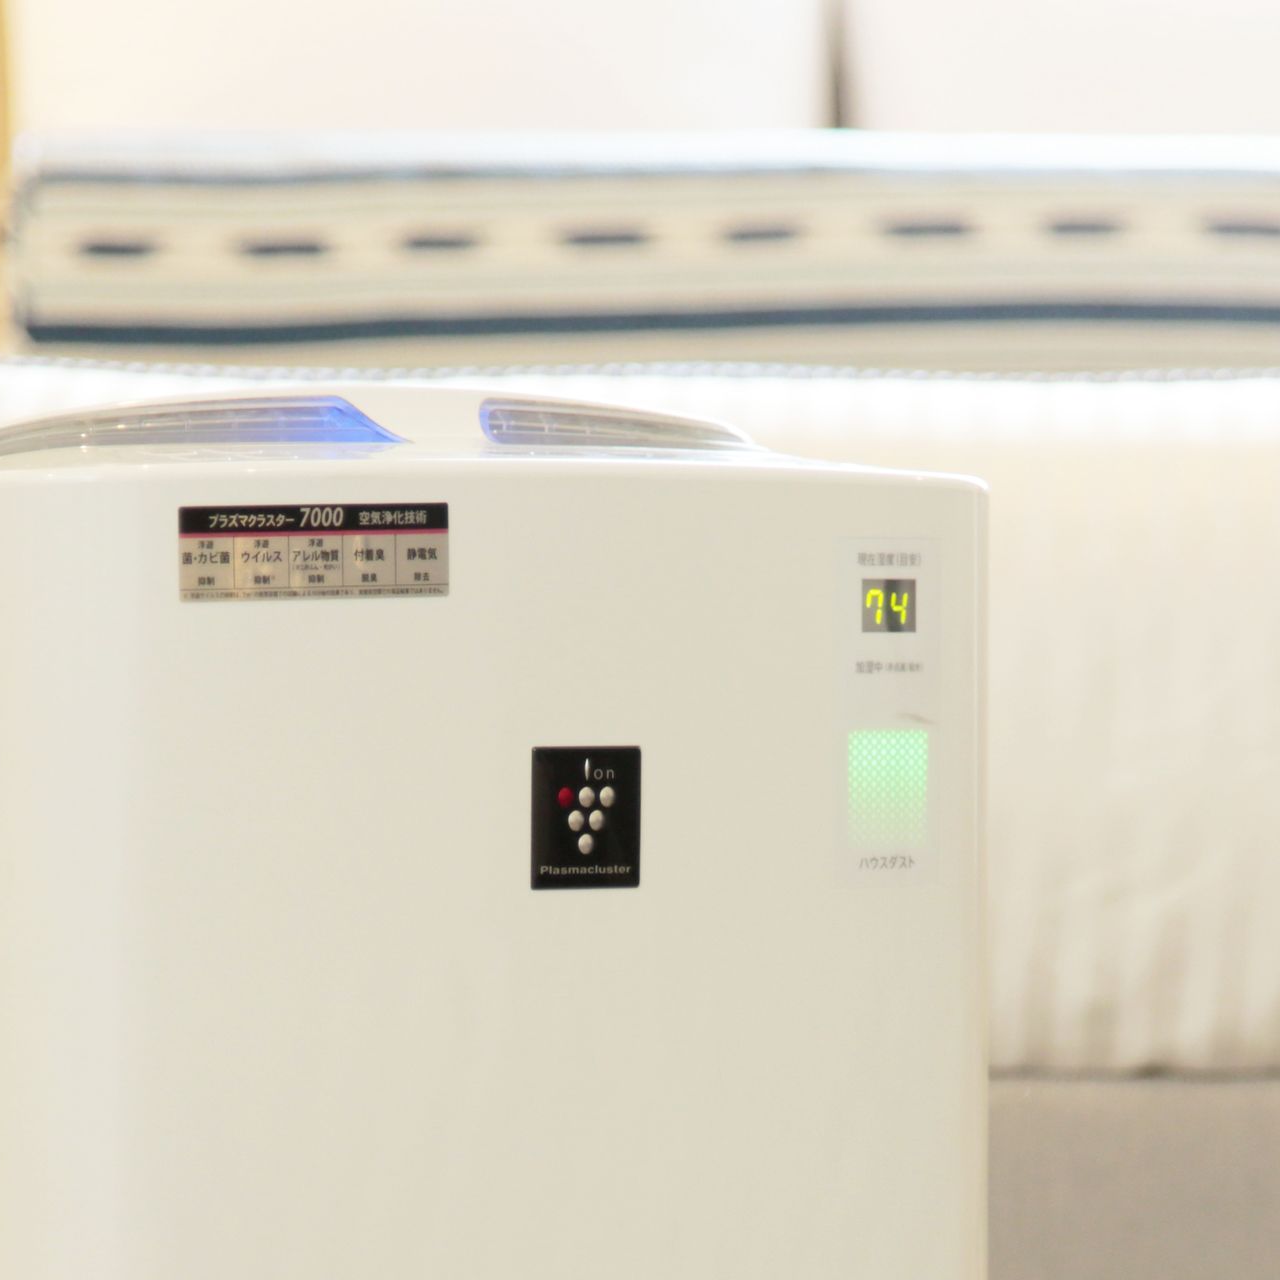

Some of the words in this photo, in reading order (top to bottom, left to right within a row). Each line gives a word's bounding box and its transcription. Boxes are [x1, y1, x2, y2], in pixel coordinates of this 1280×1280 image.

[208, 514, 295, 529] プラズマクラスター
[299, 507, 344, 527] 7000
[358, 510, 427, 525] 空気浄化技術
[241, 550, 283, 563] ウイルス
[407, 548, 438, 561] 静電気
[866, 588, 908, 625] 74
[859, 856, 916, 870] ハウスダスト
[539, 864, 631, 876] Plasmacluster
